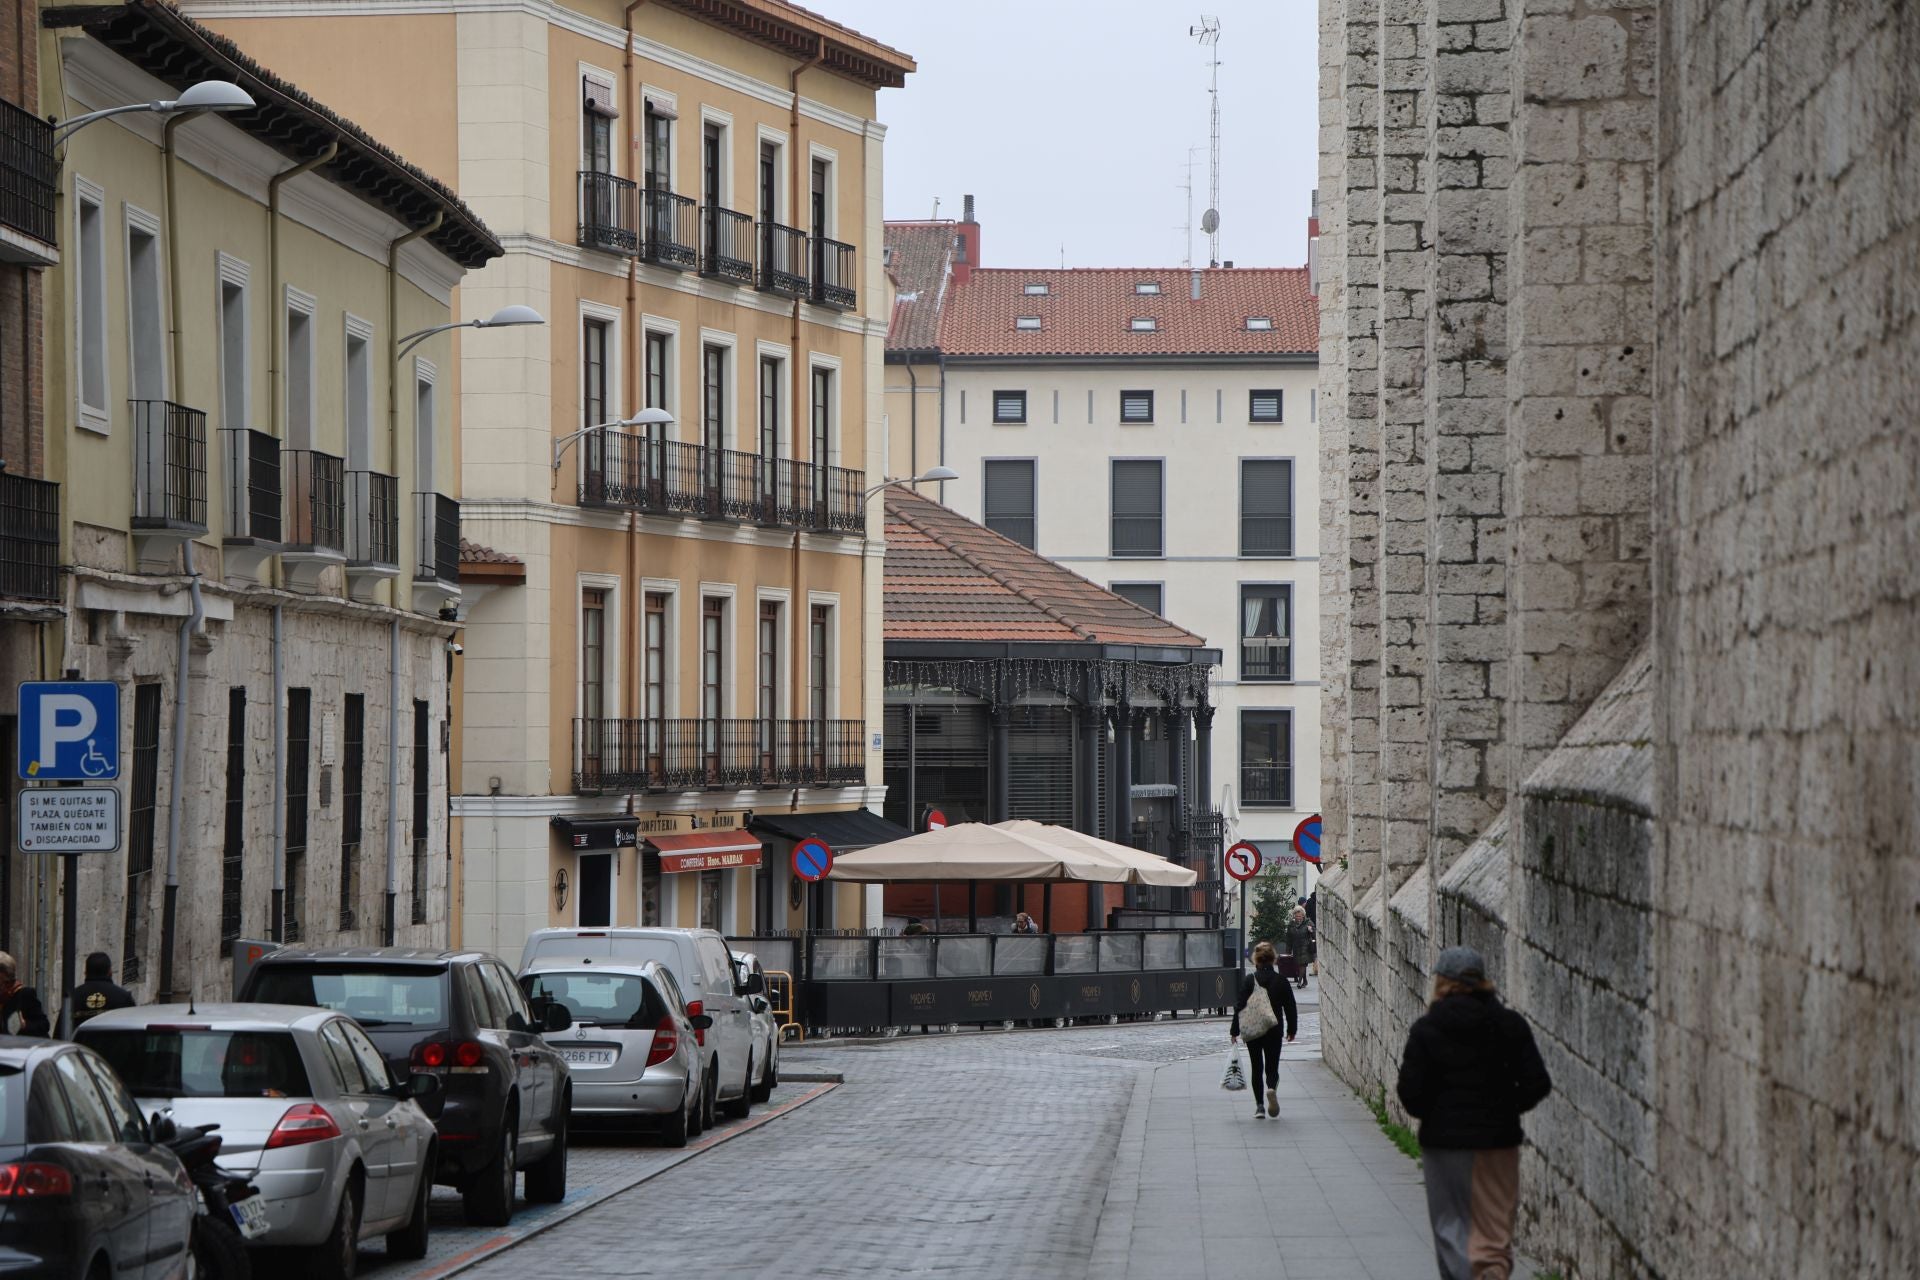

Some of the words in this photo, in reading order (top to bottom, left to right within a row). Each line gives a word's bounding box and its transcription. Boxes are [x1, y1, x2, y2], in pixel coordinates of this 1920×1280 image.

[40, 694, 97, 768] P
[30, 797, 39, 806] SI
[43, 797, 56, 806] ME
[60, 796, 93, 805] QUITAS
[96, 796, 106, 805] MI
[64, 808, 105, 818] QUÉDATE
[30, 821, 70, 831] TAMBIÉN
[74, 822, 92, 831] CON
[96, 822, 107, 830] MI
[36, 835, 101, 844] DISCAPACIDAD
[248, 945, 264, 966] P
[588, 1051, 610, 1062] FTX
